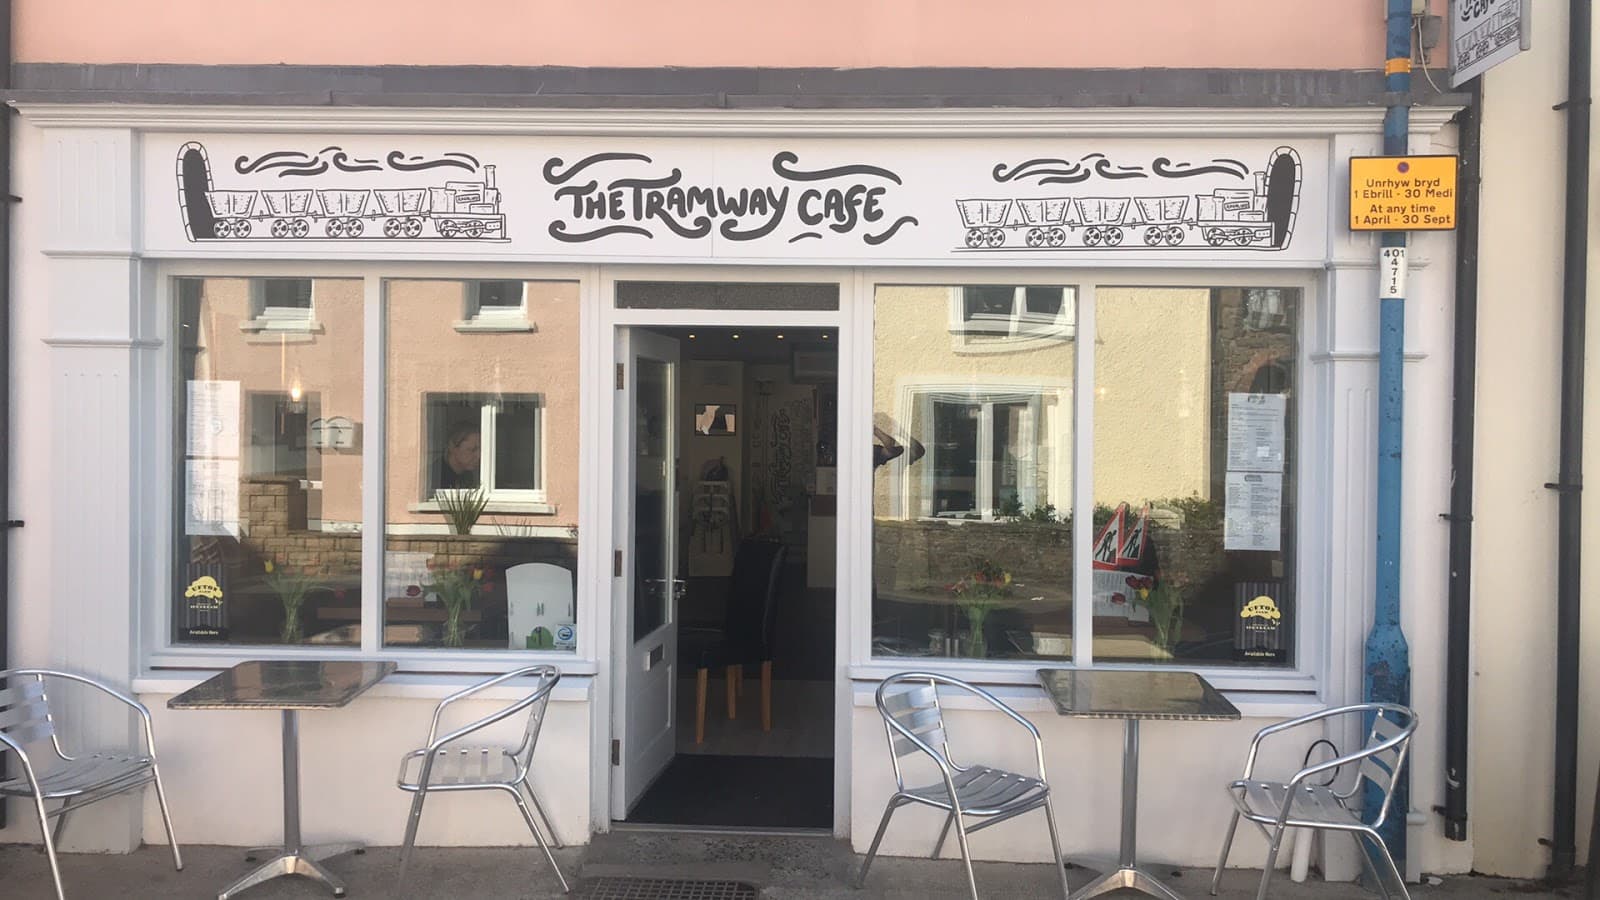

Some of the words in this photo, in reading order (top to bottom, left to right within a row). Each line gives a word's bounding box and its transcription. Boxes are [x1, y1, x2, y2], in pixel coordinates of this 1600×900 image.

[1366, 178, 1410, 189] Unrhyw
[1414, 178, 1440, 188] bryd
[1354, 190, 1358, 199] 1
[1363, 189, 1393, 199] Ebrill
[1404, 189, 1421, 198] 30
[1425, 188, 1453, 198] Medi
[554, 180, 626, 220] THE
[608, 168, 790, 241] TRAMWAY
[797, 185, 887, 234] CAFE
[1370, 204, 1383, 213] At
[1386, 205, 1407, 214] any
[1410, 204, 1436, 213] time
[1355, 215, 1359, 224] 1
[1363, 215, 1391, 225] April
[1402, 214, 1419, 224] 30
[1423, 214, 1451, 225] Sept
[1383, 249, 1405, 258] 401
